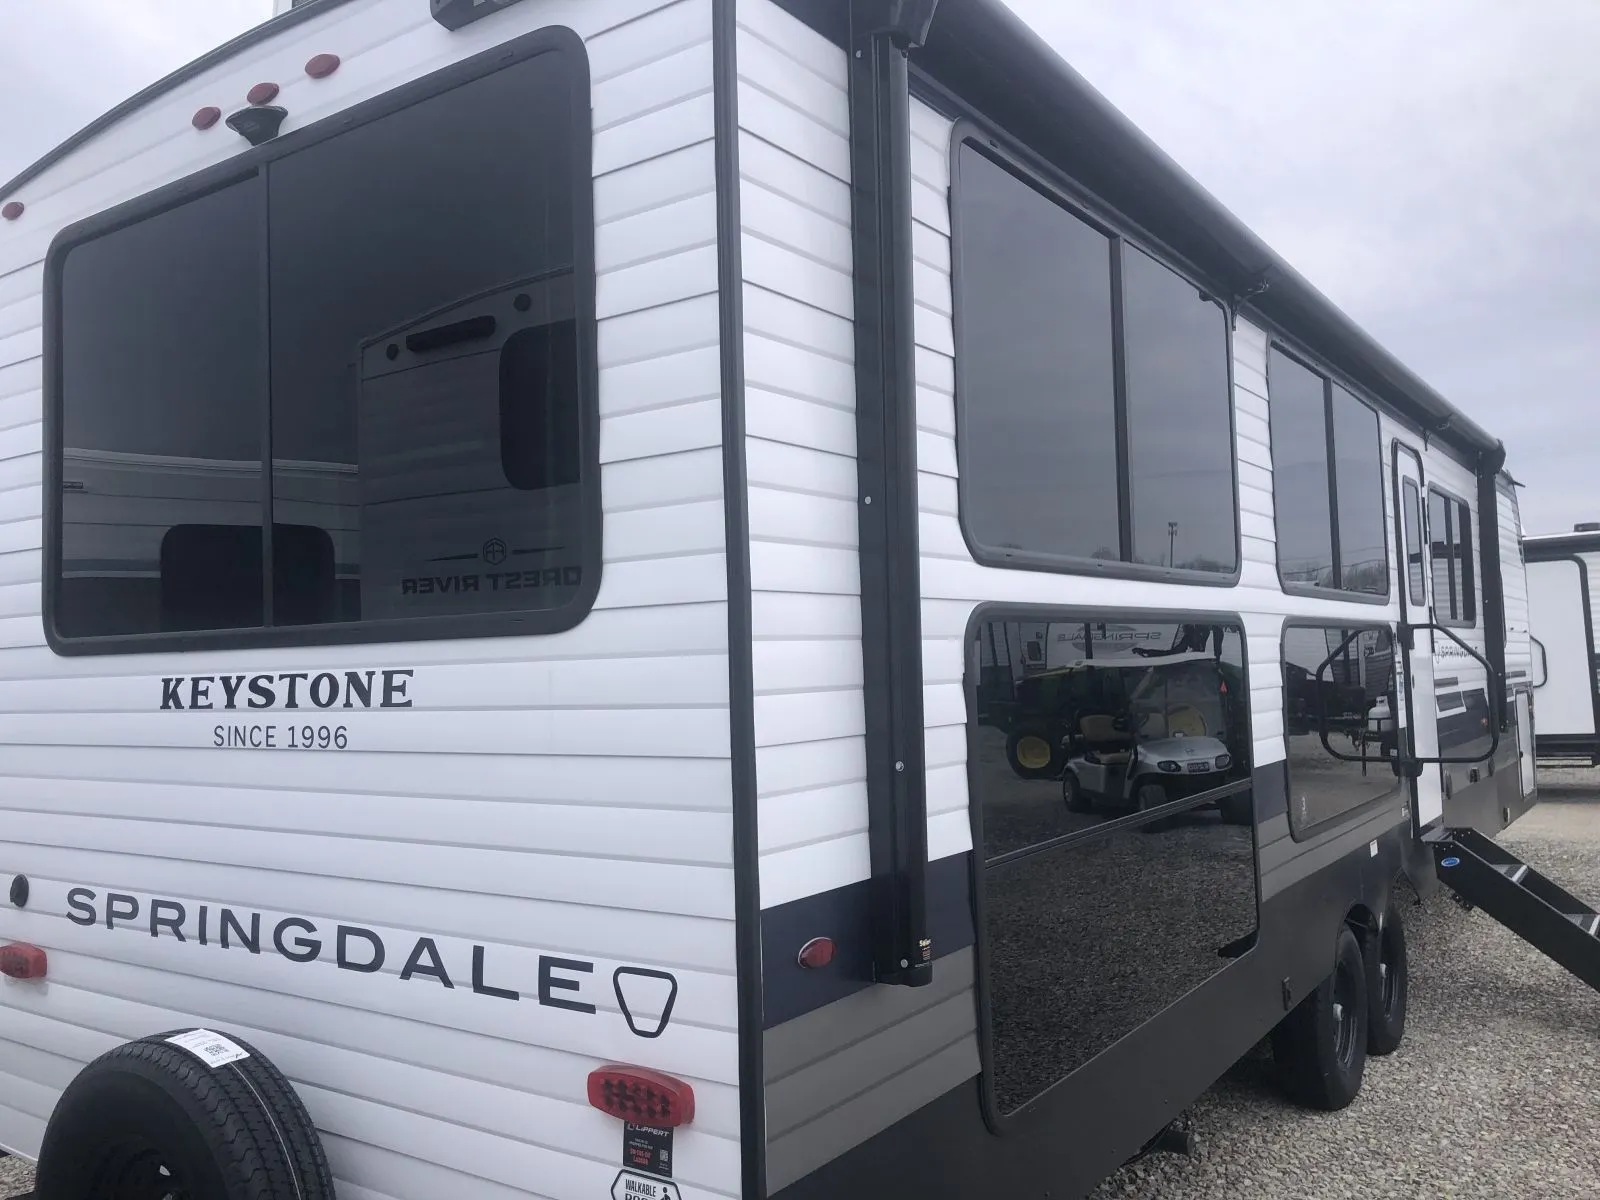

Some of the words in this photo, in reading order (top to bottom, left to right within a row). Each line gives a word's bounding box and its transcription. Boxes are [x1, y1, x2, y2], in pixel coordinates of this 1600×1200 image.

[160, 669, 414, 710] KEYSTONE
[213, 725, 277, 748] SINCE
[287, 725, 348, 750] 1996
[65, 887, 597, 1014] SPRINGDALE
[635, 1124, 670, 1137] LIPPERT
[625, 1178, 657, 1198] WALKABLE
